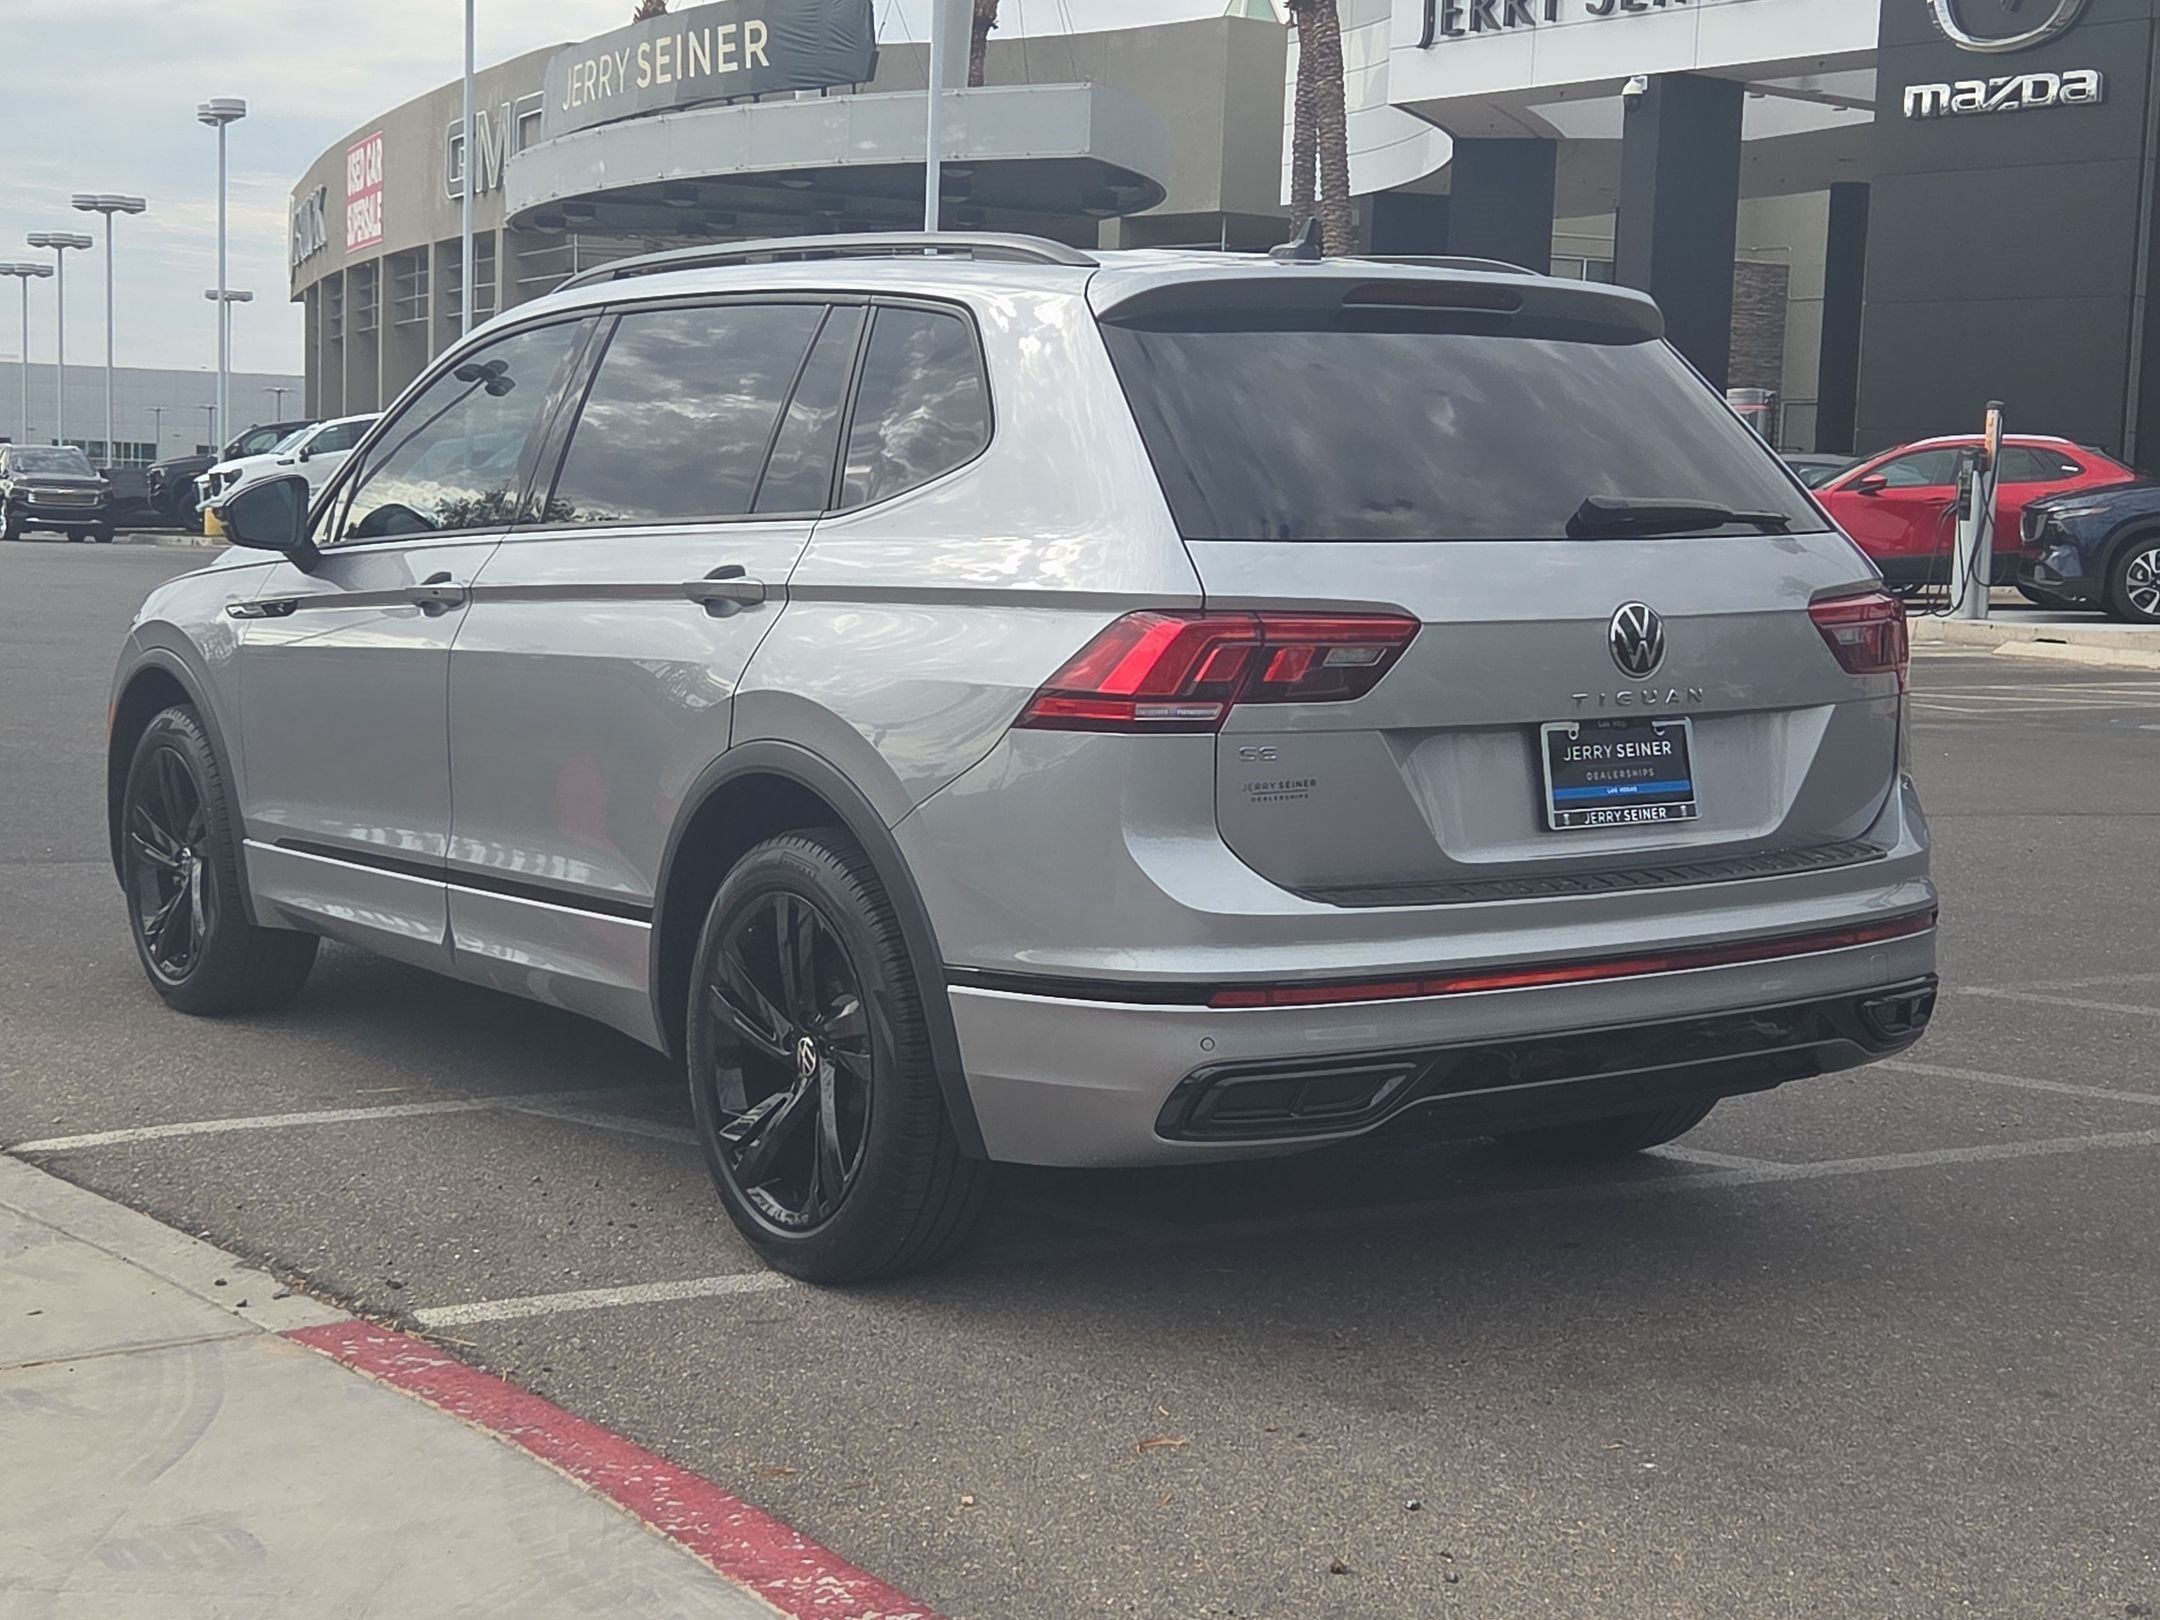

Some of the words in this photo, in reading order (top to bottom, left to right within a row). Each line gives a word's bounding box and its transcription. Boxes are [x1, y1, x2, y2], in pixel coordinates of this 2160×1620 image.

[562, 47, 630, 111] JERRY
[636, 19, 770, 89] SEINER
[1571, 688, 1703, 710] TIGUAN
[1239, 745, 1278, 762] SE
[1563, 744, 1613, 762] JERRY
[1616, 740, 1673, 758] SEINER
[1586, 768, 1655, 781] DEALERSHIPS
[1241, 782, 1277, 793] JERRY
[1279, 778, 1317, 789] SEINER
[1584, 810, 1622, 825] JERRY
[1623, 807, 1667, 822] SEINER
